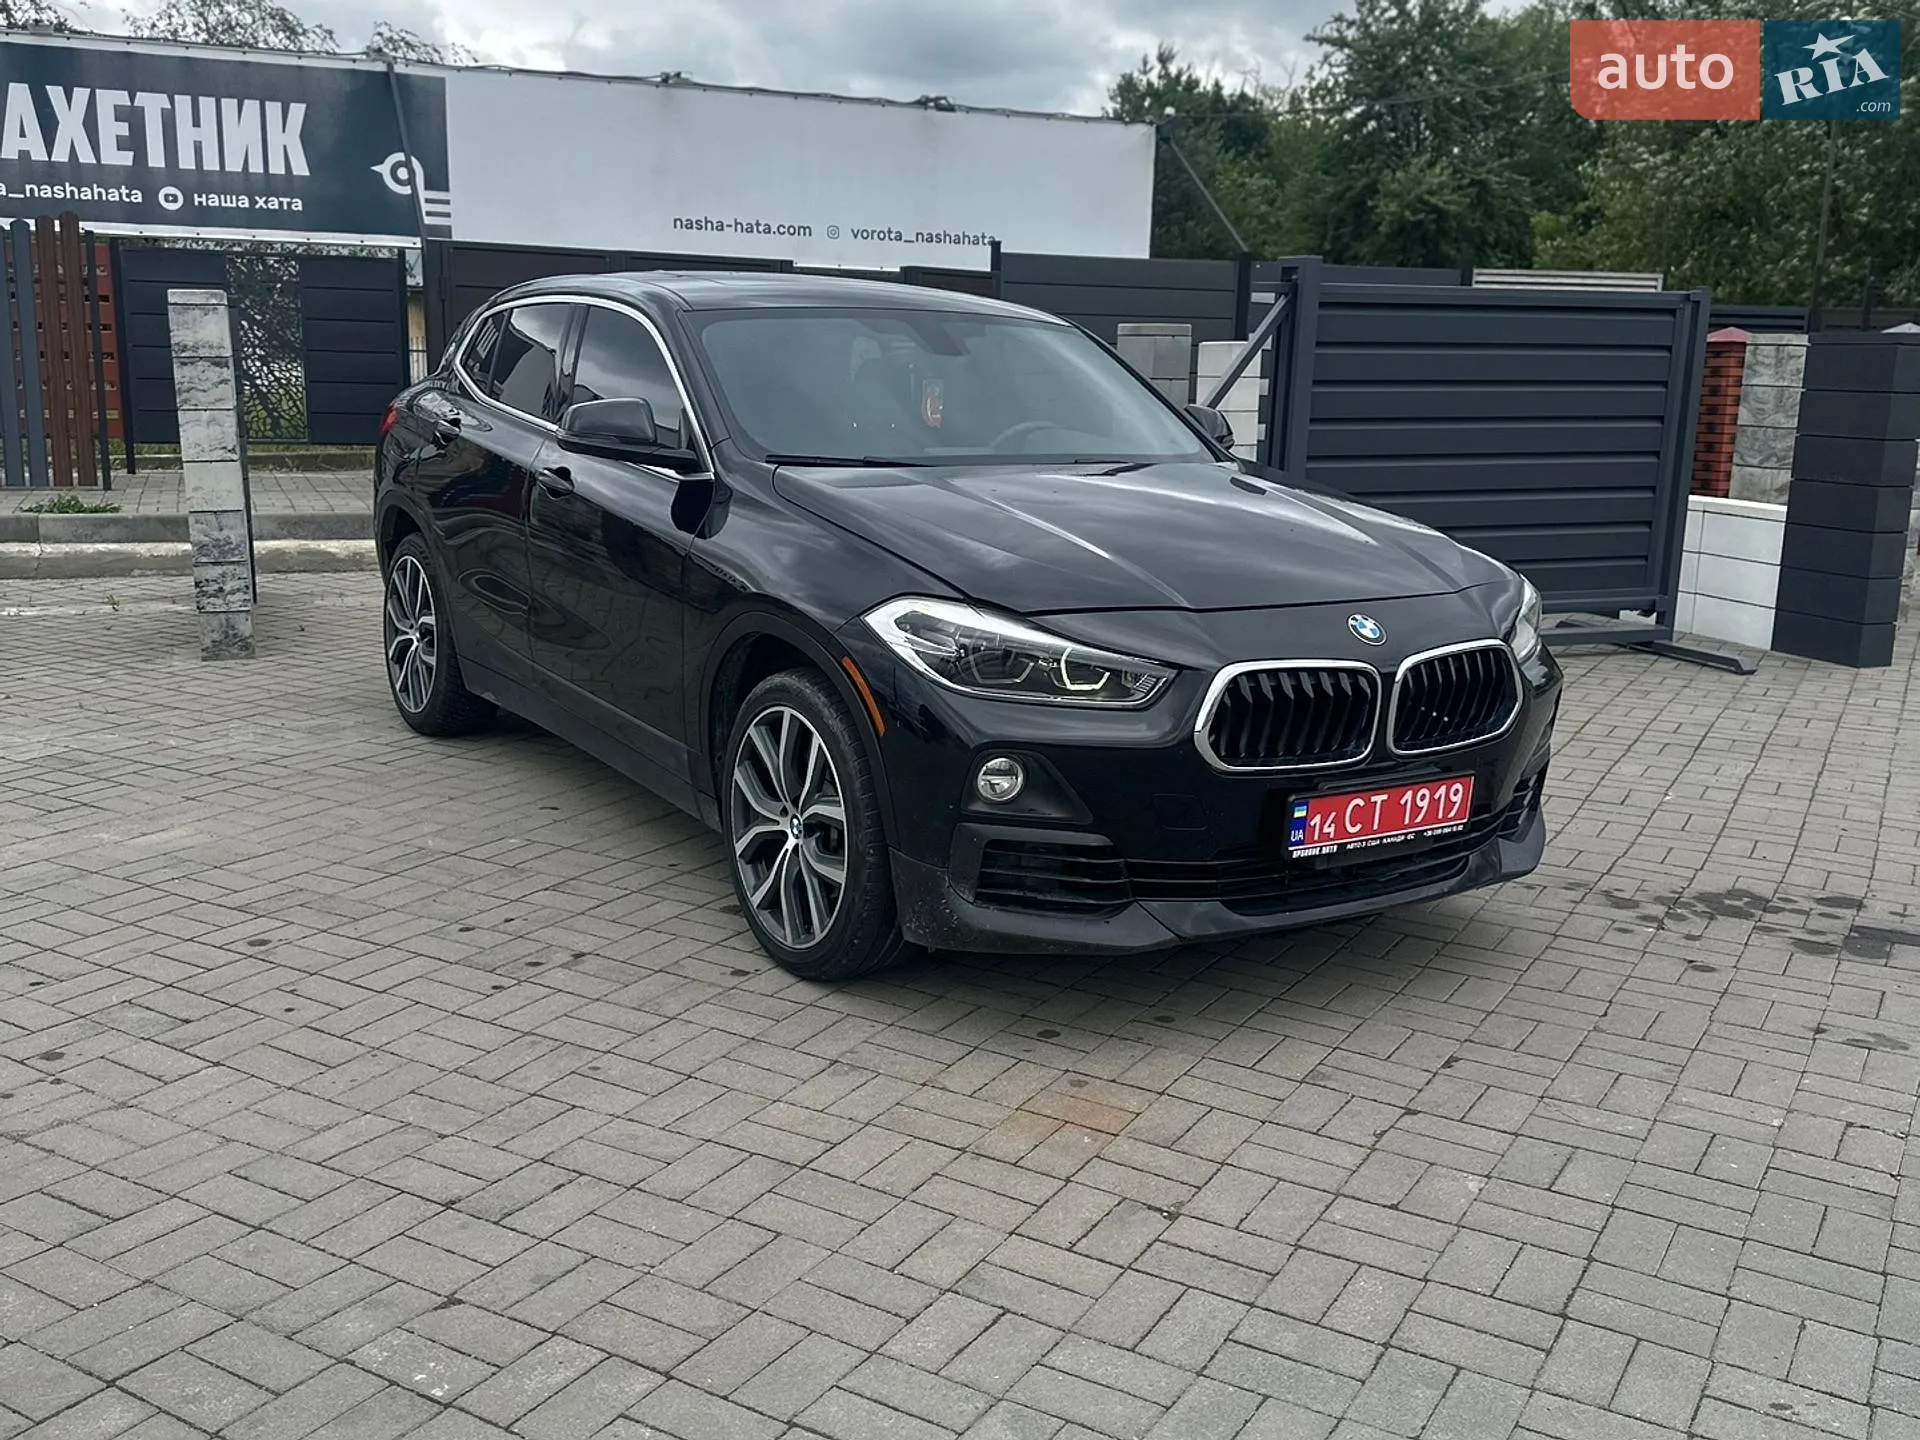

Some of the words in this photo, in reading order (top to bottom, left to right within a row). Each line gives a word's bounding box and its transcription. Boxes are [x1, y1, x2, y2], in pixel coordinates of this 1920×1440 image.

[0, 82, 311, 176] АХЕТНИК
[193, 193, 250, 208] наша
[254, 195, 303, 211] хата
[672, 216, 813, 238] nasha-hata.com
[1309, 811, 1337, 841] 14
[1400, 782, 1463, 826] 1919
[1290, 829, 1304, 842] UA
